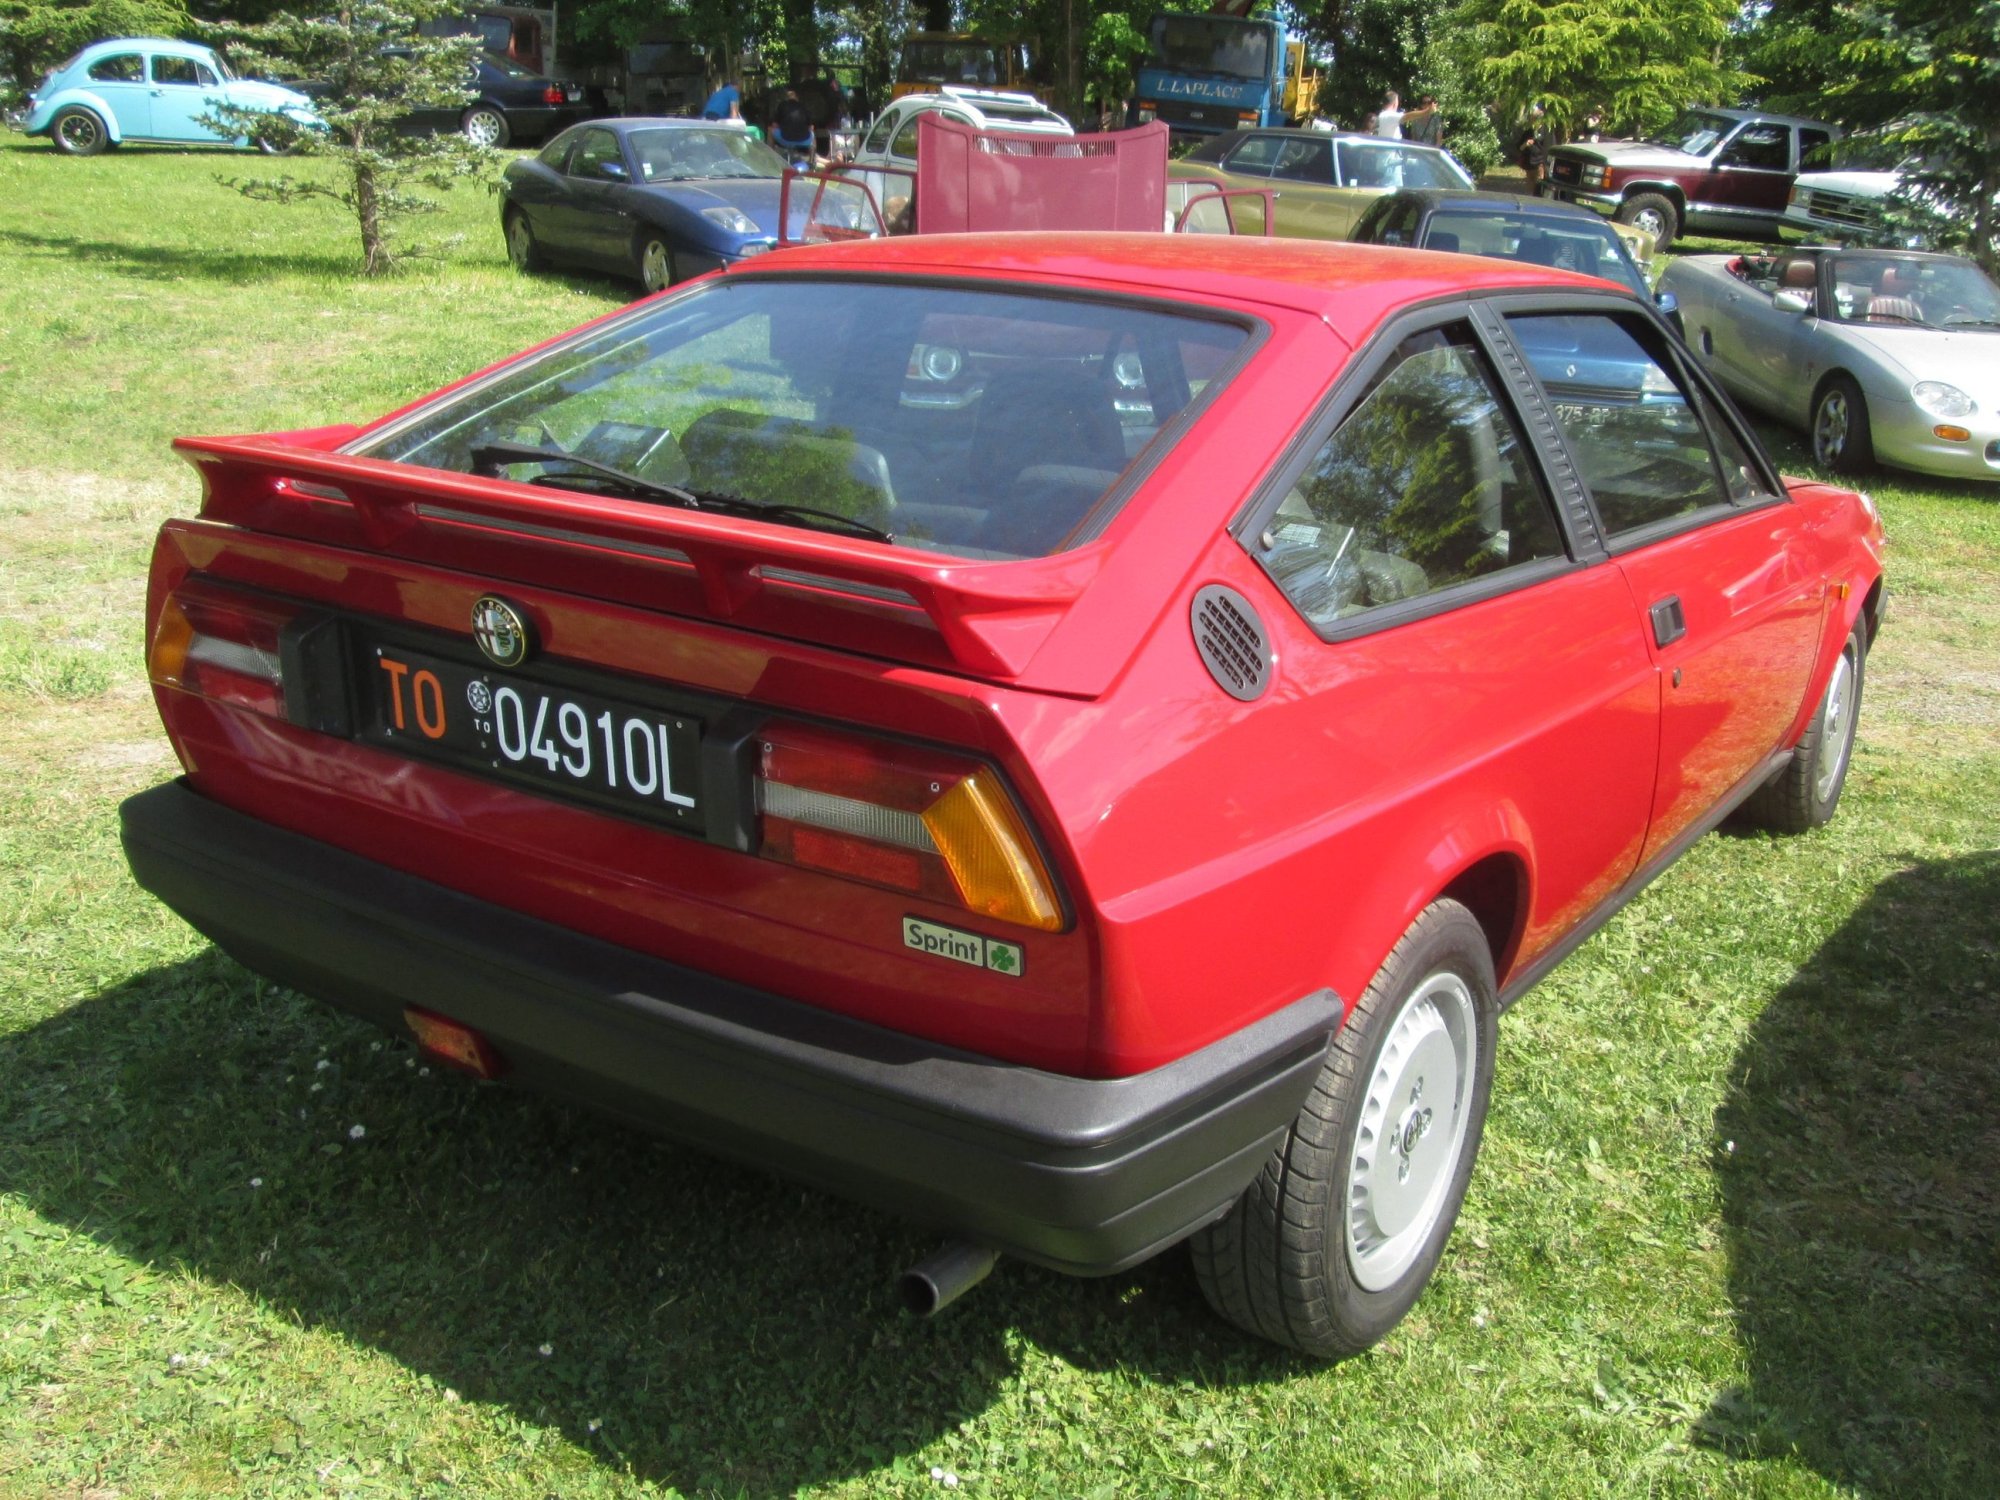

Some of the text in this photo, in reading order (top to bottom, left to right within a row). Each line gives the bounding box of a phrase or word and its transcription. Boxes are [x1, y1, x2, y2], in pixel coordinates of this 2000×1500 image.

[488, 601, 521, 638] ROMEO
[380, 658, 695, 808] TO 04910L
[474, 718, 491, 734] TO
[909, 923, 978, 961] Sprint
